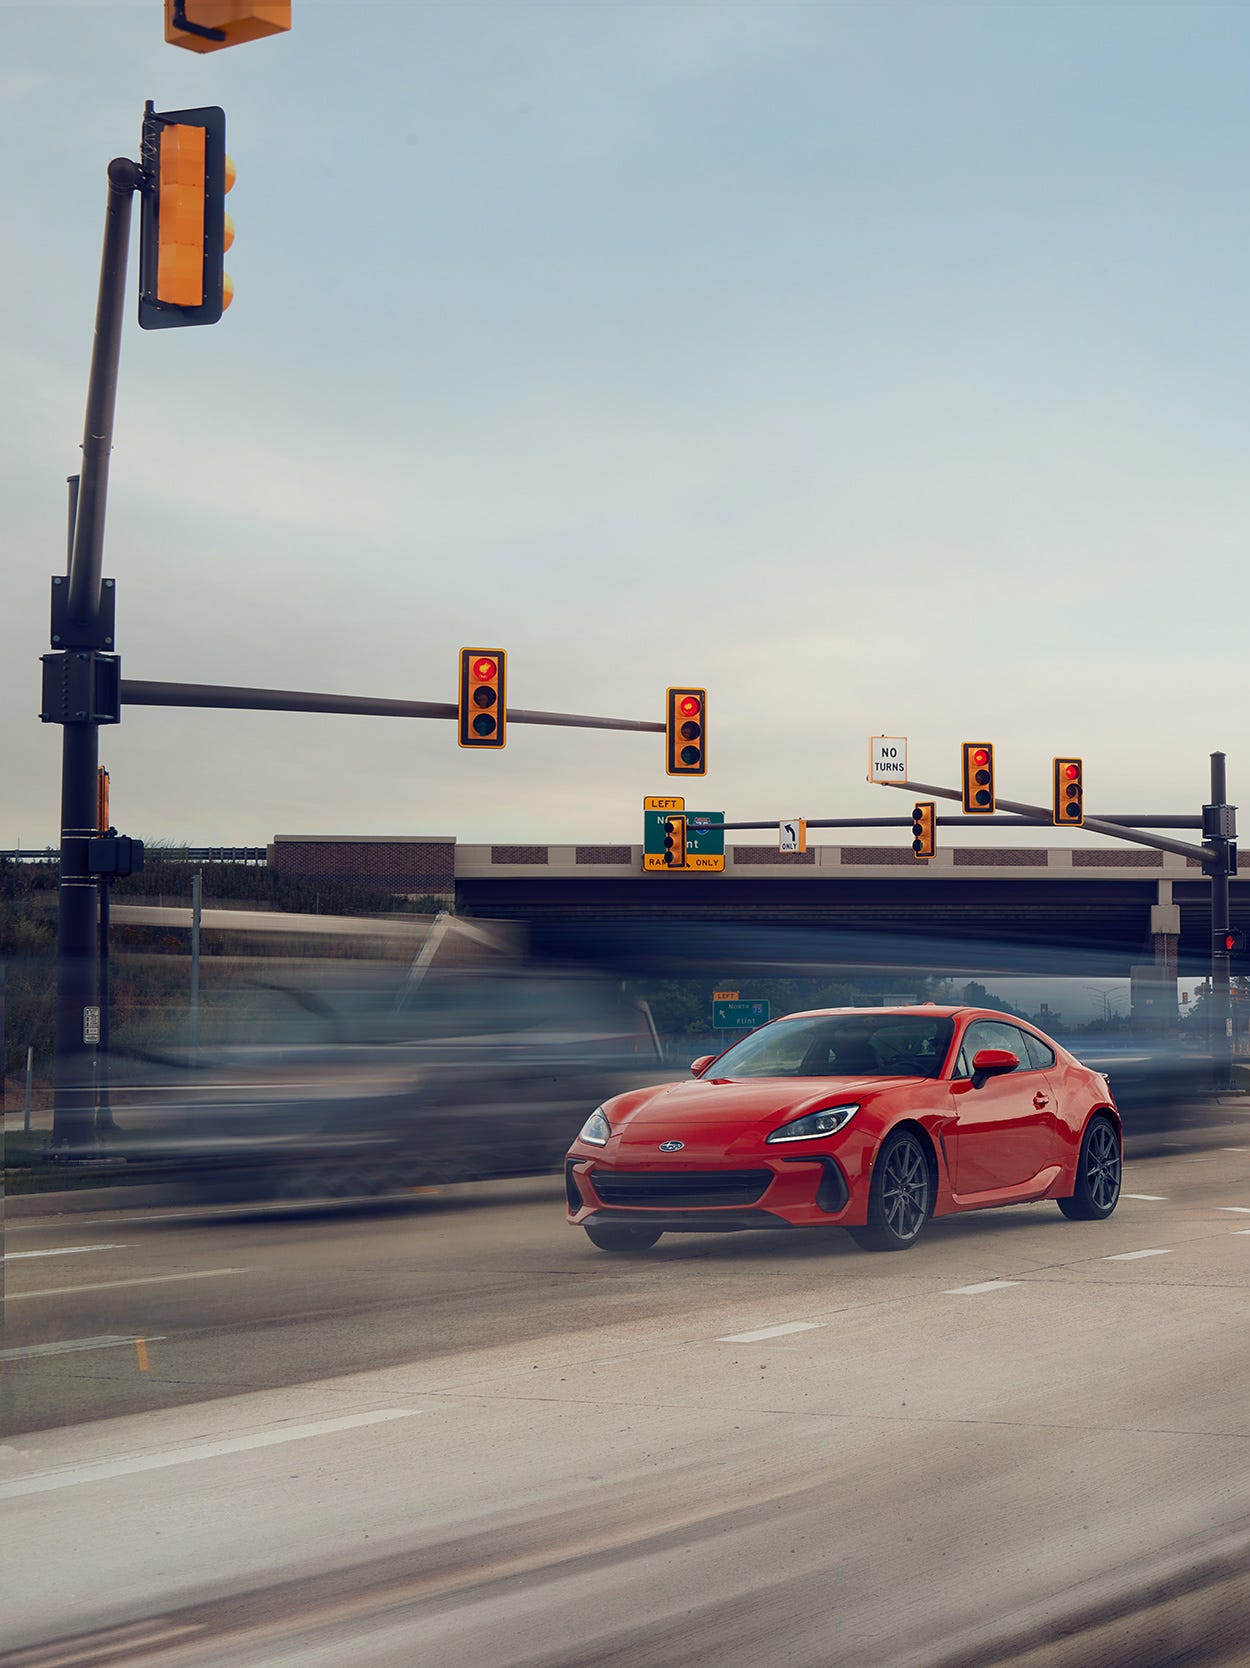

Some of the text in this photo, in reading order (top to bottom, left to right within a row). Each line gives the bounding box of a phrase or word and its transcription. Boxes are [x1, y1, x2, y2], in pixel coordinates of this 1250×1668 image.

[881, 747, 897, 758] NO
[875, 762, 905, 772] TURNS
[651, 800, 677, 808] LEFT
[695, 859, 719, 867] ONLY
